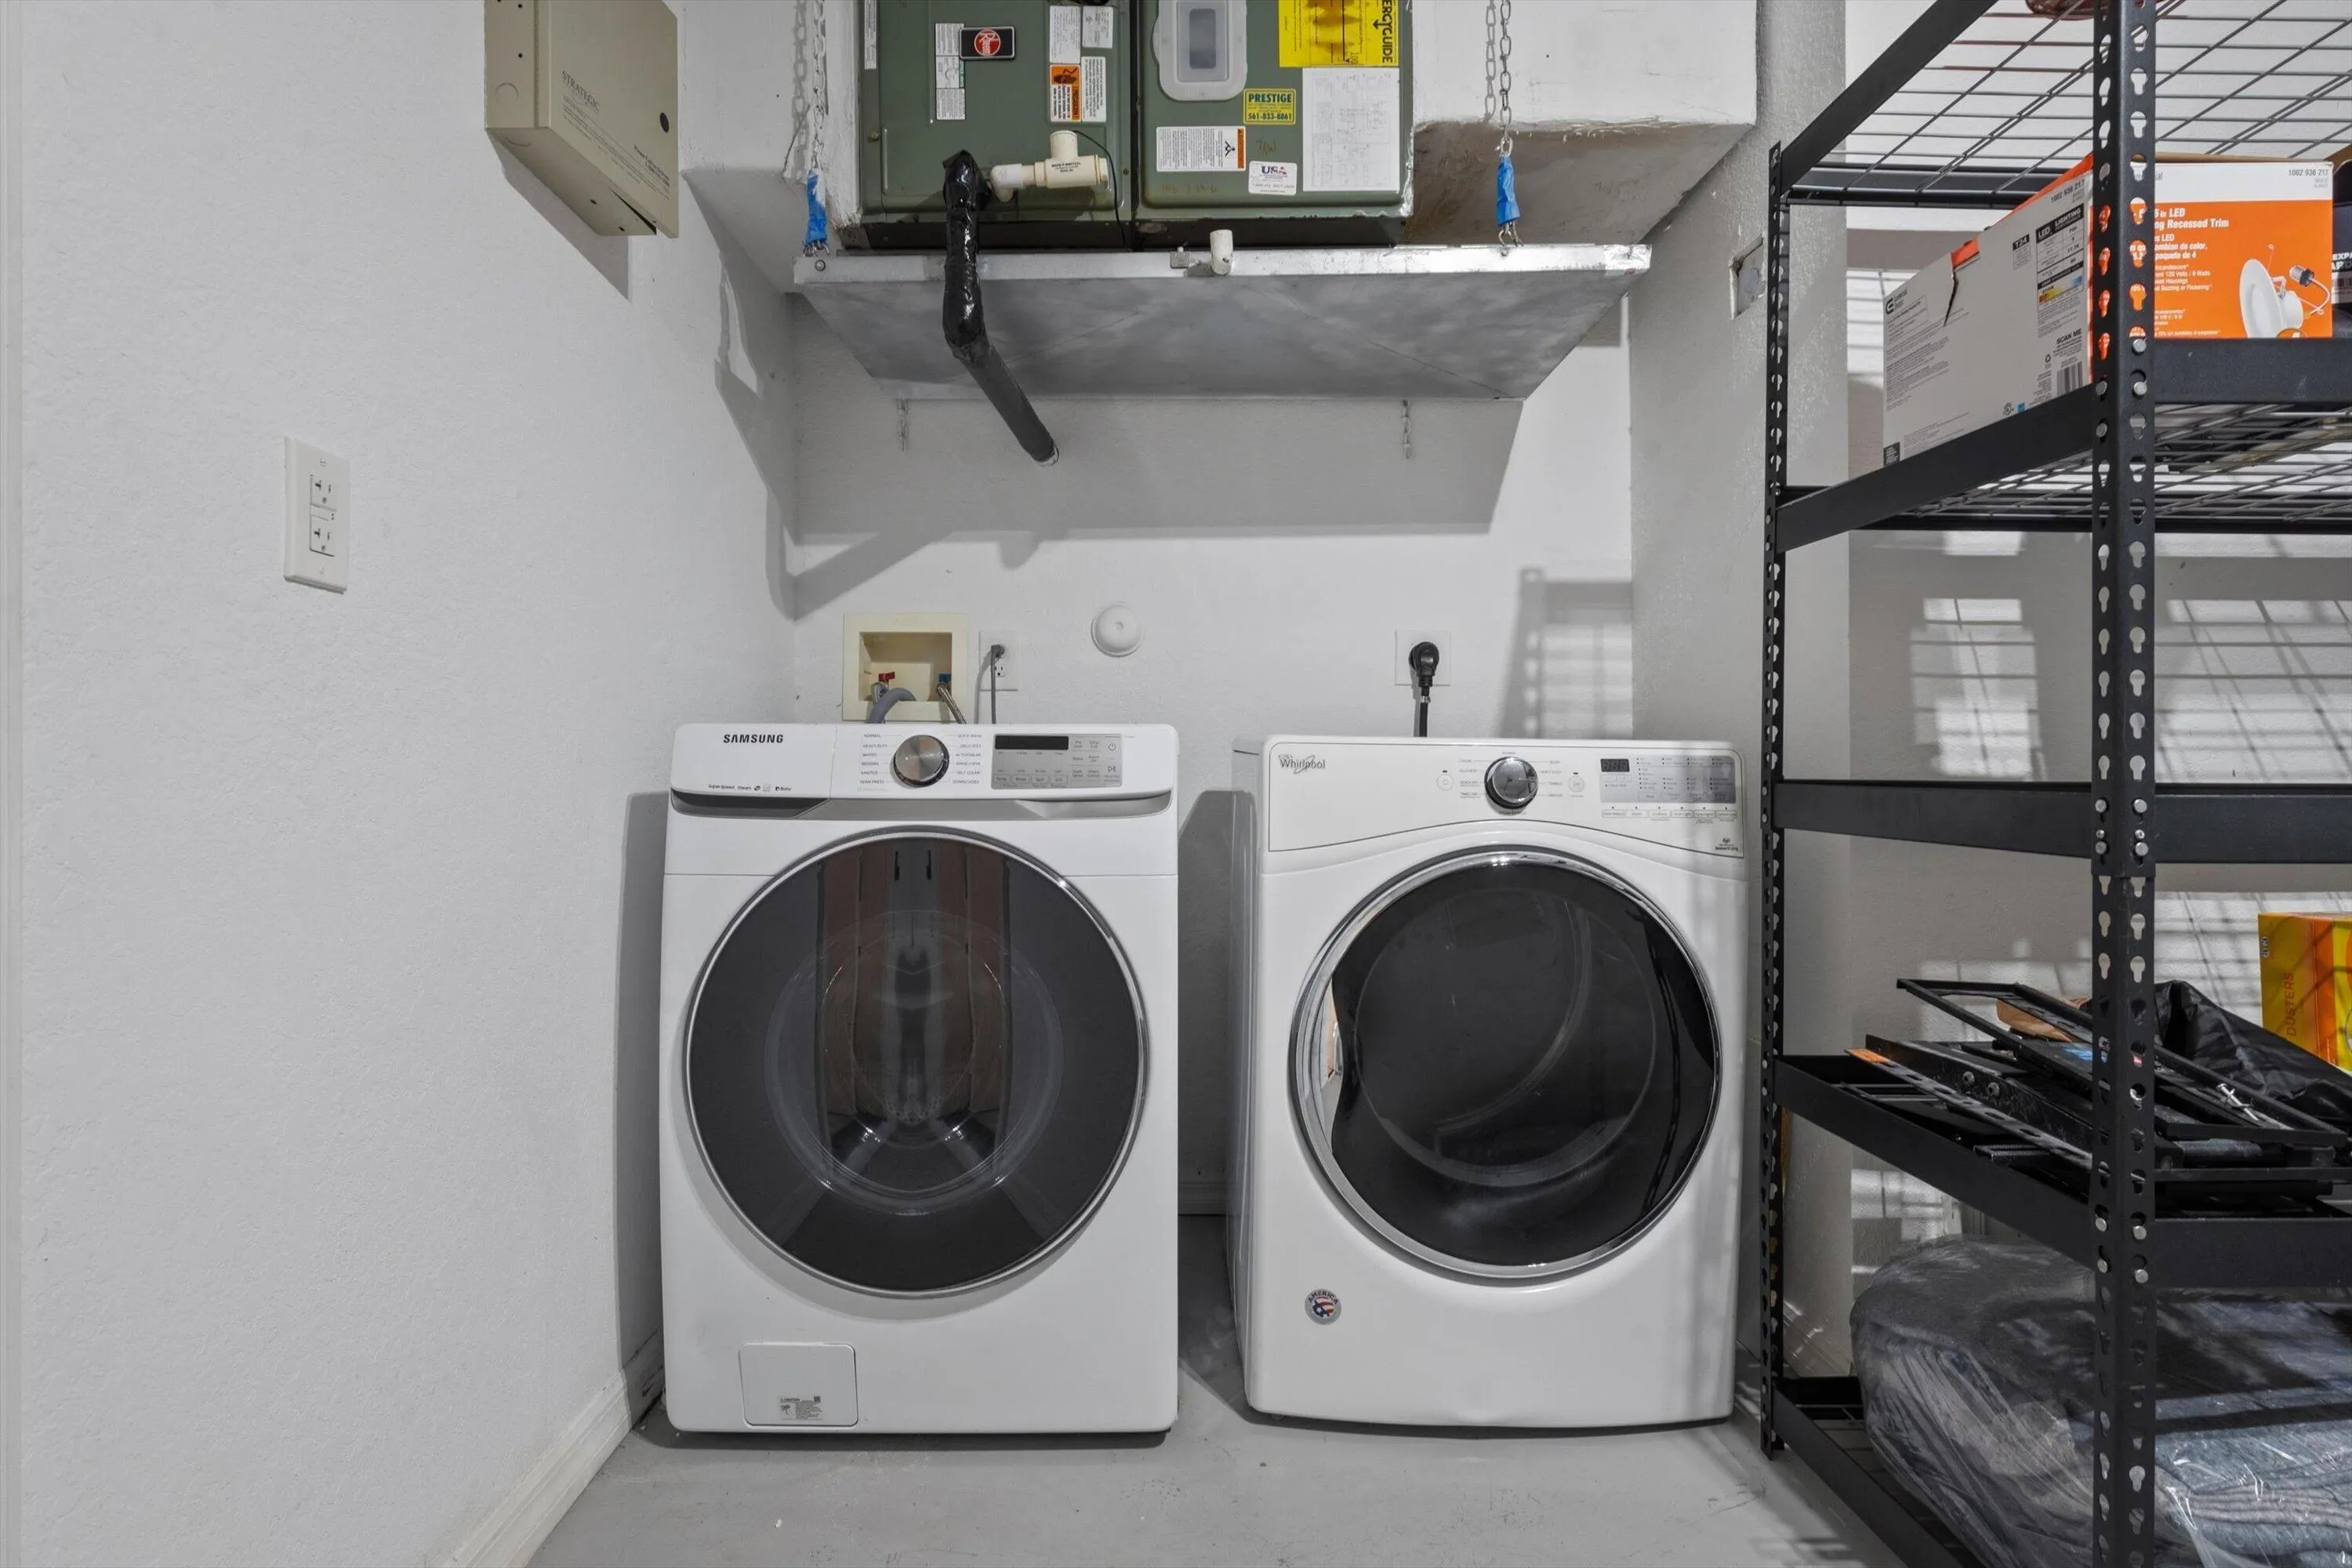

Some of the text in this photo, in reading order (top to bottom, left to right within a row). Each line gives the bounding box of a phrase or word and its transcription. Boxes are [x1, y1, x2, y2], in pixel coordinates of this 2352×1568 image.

[561, 70, 601, 113] STRATEGIC
[1248, 93, 1292, 103] PRESTIGE
[1261, 165, 1287, 175] USA
[2054, 207, 2082, 227] LIGHTING
[2169, 208, 2186, 217] LED
[2167, 220, 2208, 229] Recessed
[2210, 218, 2230, 228] Trim
[2038, 227, 2050, 238] LED
[2056, 328, 2082, 345] SCAN ME
[723, 734, 784, 744] SAMSUNG
[1279, 757, 1326, 771] Whirlpool
[2285, 971, 2297, 1037] DUSTERS
[1308, 1290, 1339, 1305] AMERICA
